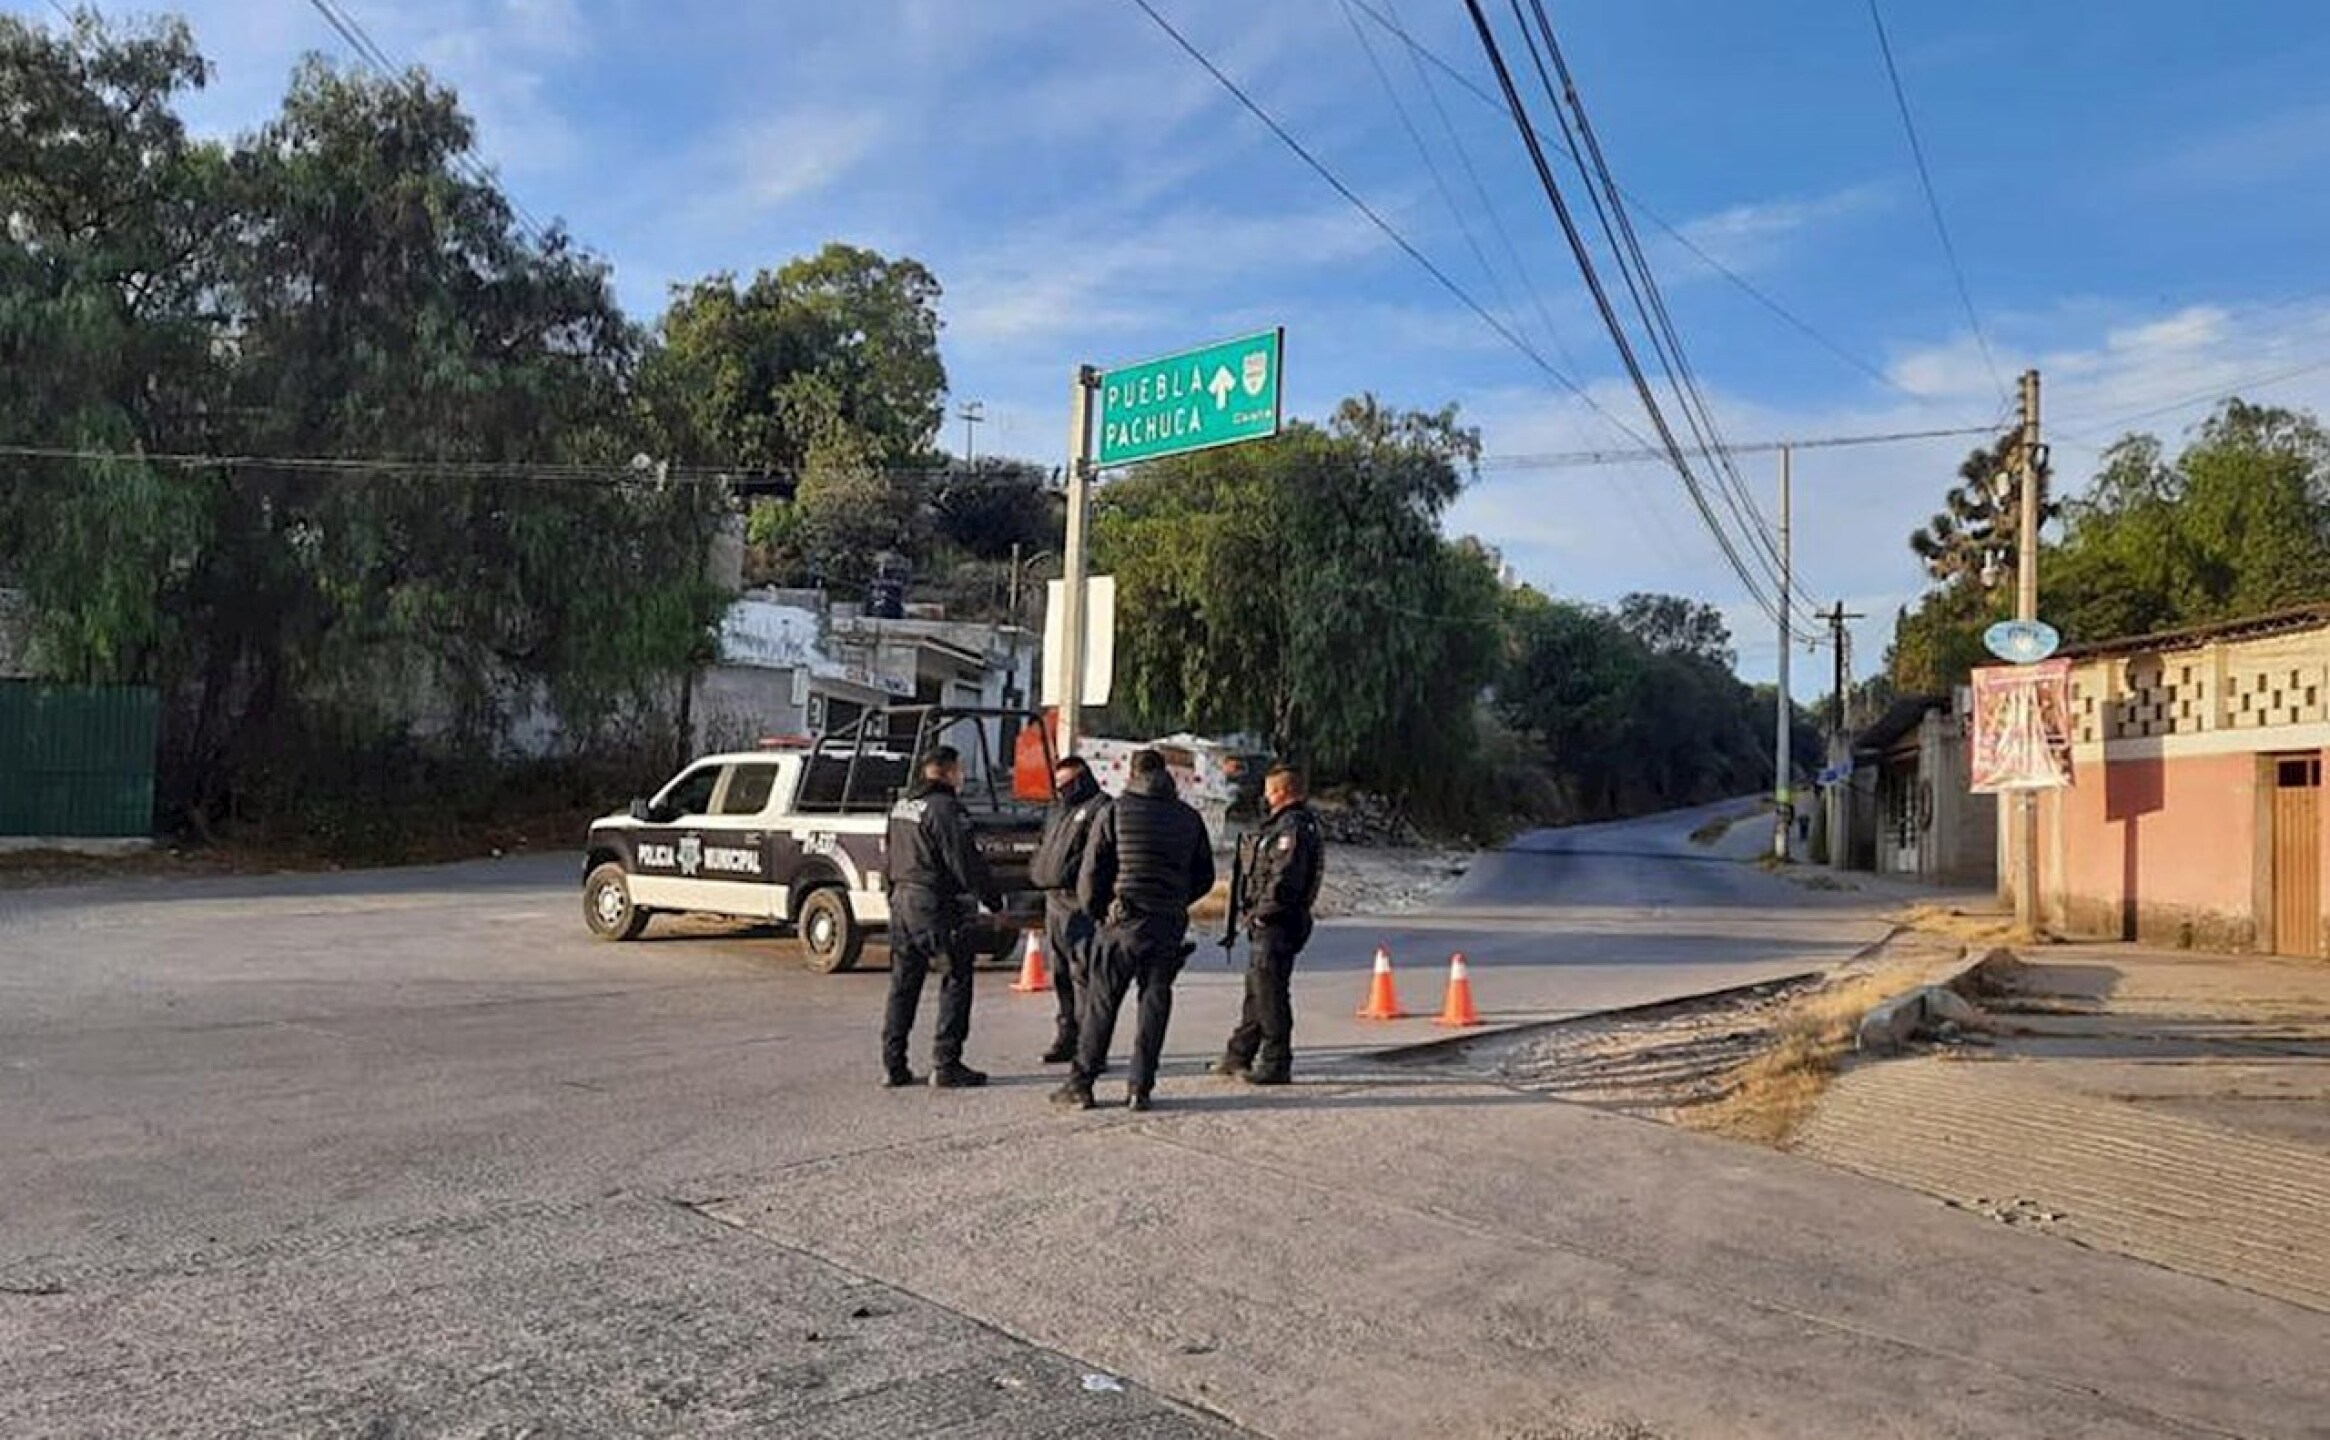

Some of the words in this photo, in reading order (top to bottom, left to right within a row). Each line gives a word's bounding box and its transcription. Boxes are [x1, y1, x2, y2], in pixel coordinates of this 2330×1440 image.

[1108, 364, 1204, 410] PUEBLA
[1106, 405, 1201, 450] PACHUCA
[638, 843, 675, 868] POLICIA
[703, 846, 761, 873] MUNICIPAL
